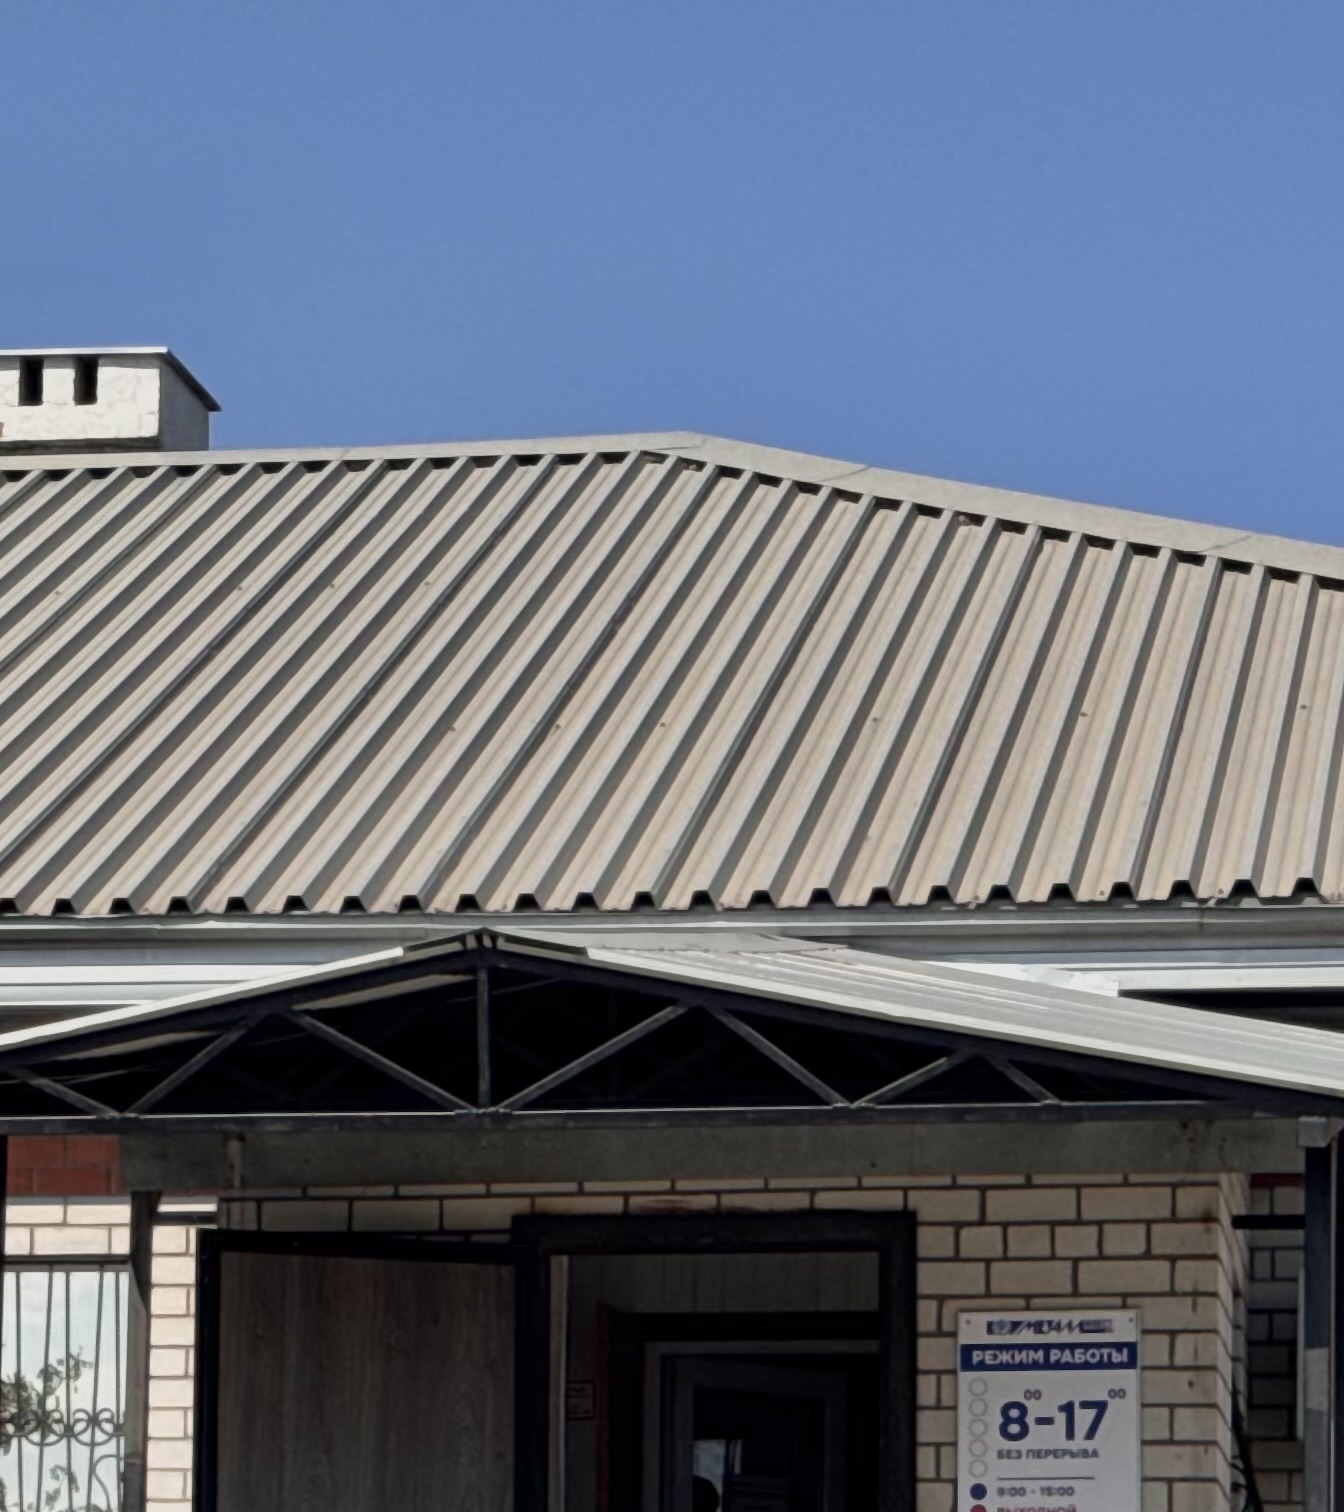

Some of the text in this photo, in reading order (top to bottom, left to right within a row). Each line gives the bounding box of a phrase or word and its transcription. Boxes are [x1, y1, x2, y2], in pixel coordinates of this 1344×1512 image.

[972, 1347, 1129, 1366] РЕЖИМ РАБОТЫ
[997, 1447, 1100, 1460] БЕЗ ПЕРЕРЫВА
